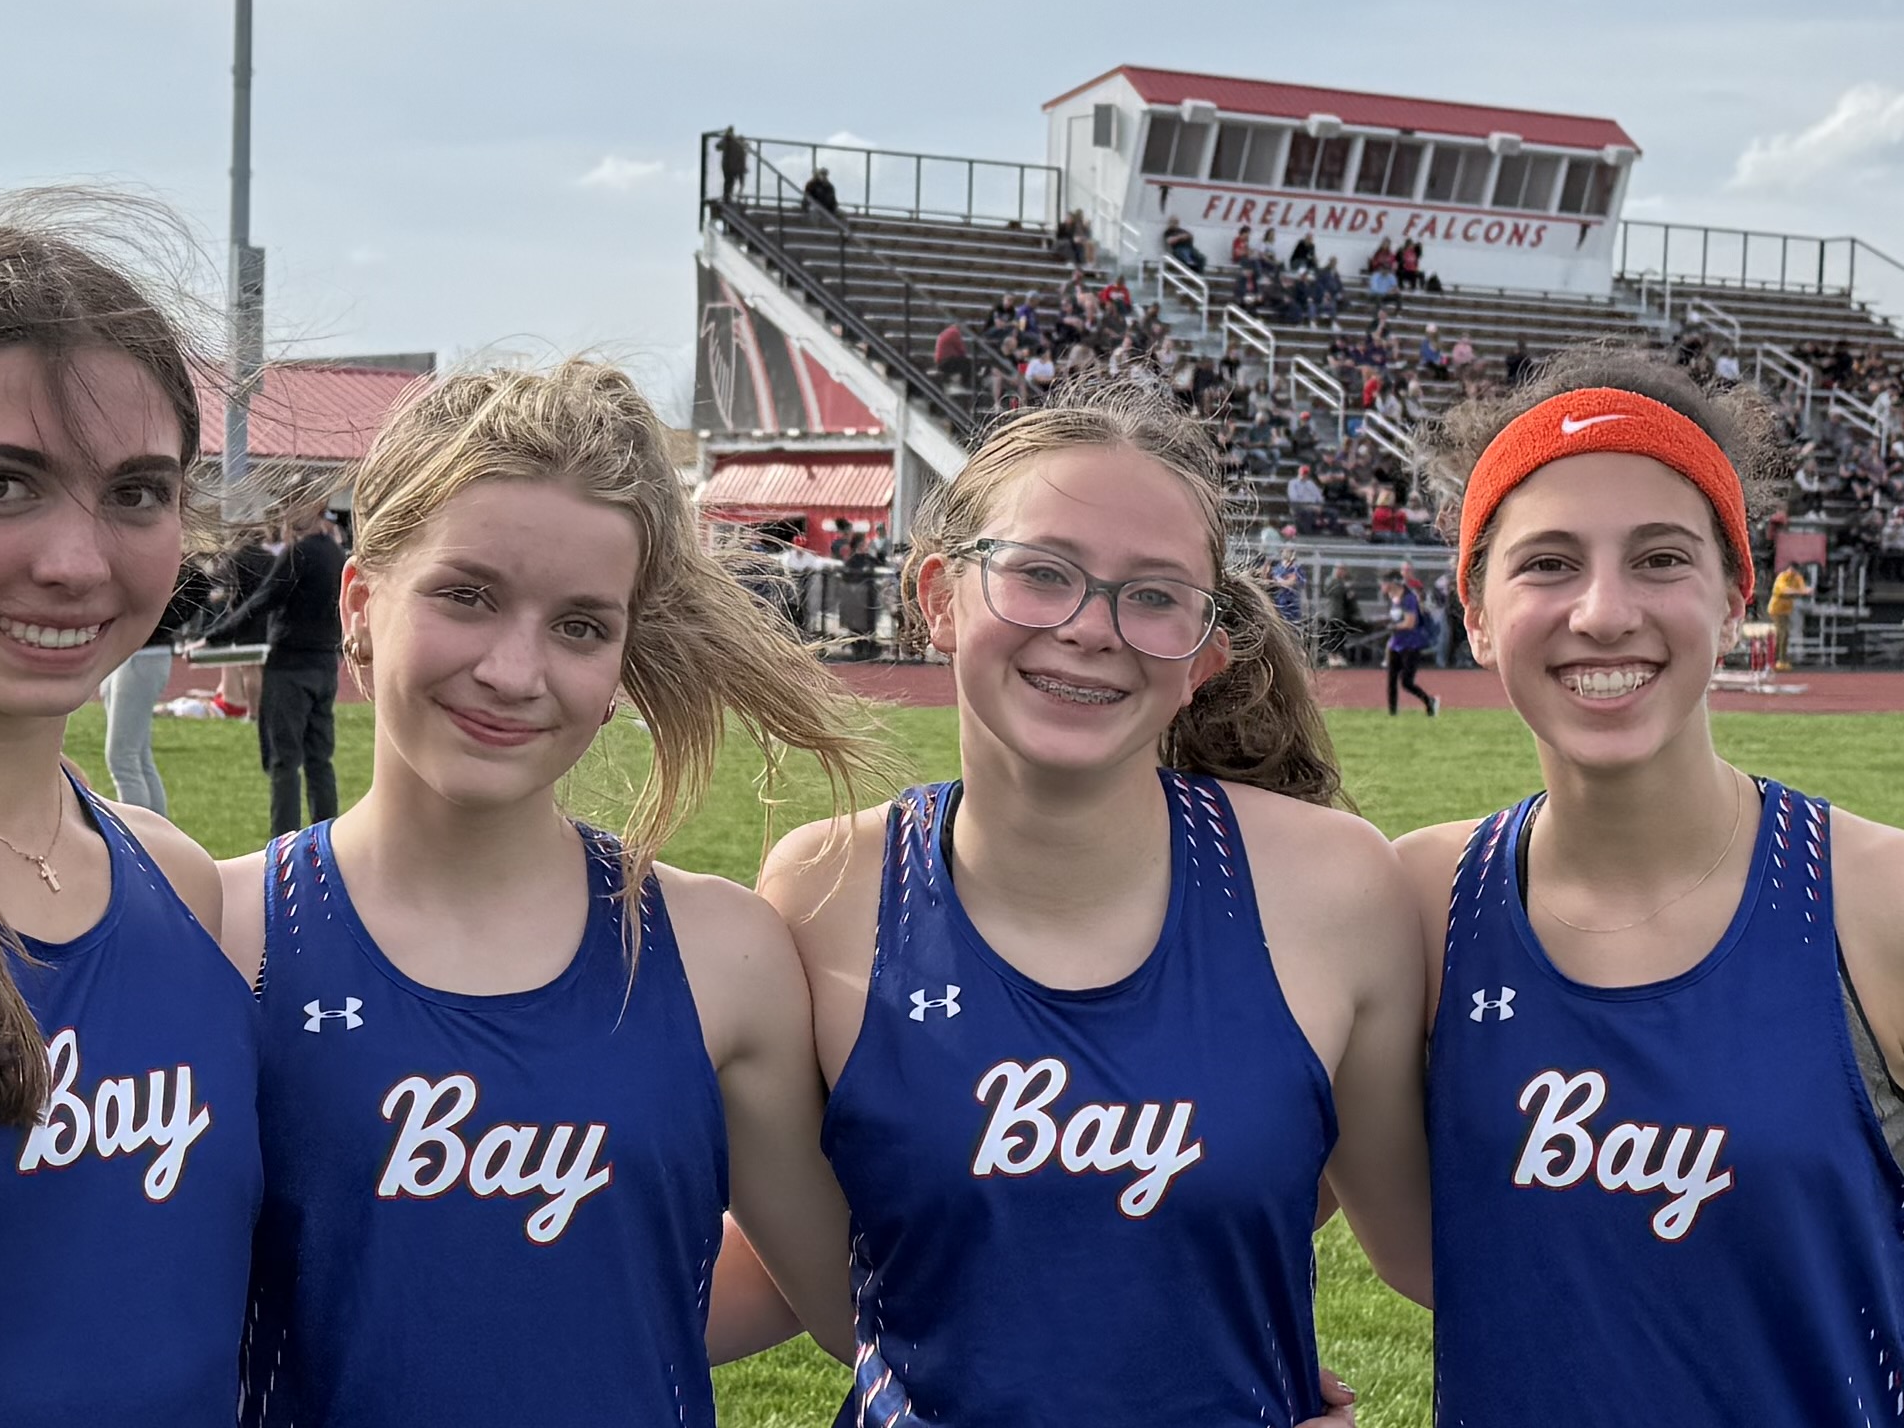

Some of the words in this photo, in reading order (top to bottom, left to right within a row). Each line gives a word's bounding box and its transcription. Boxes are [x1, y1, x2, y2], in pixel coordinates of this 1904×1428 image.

[1202, 194, 1389, 234] FIRELANDS
[1402, 212, 1549, 249] FALCONS
[16, 1025, 212, 1203] Bay
[375, 1073, 614, 1245] Bay
[973, 1055, 1204, 1220] Bay
[1512, 1066, 1734, 1242] Bay
